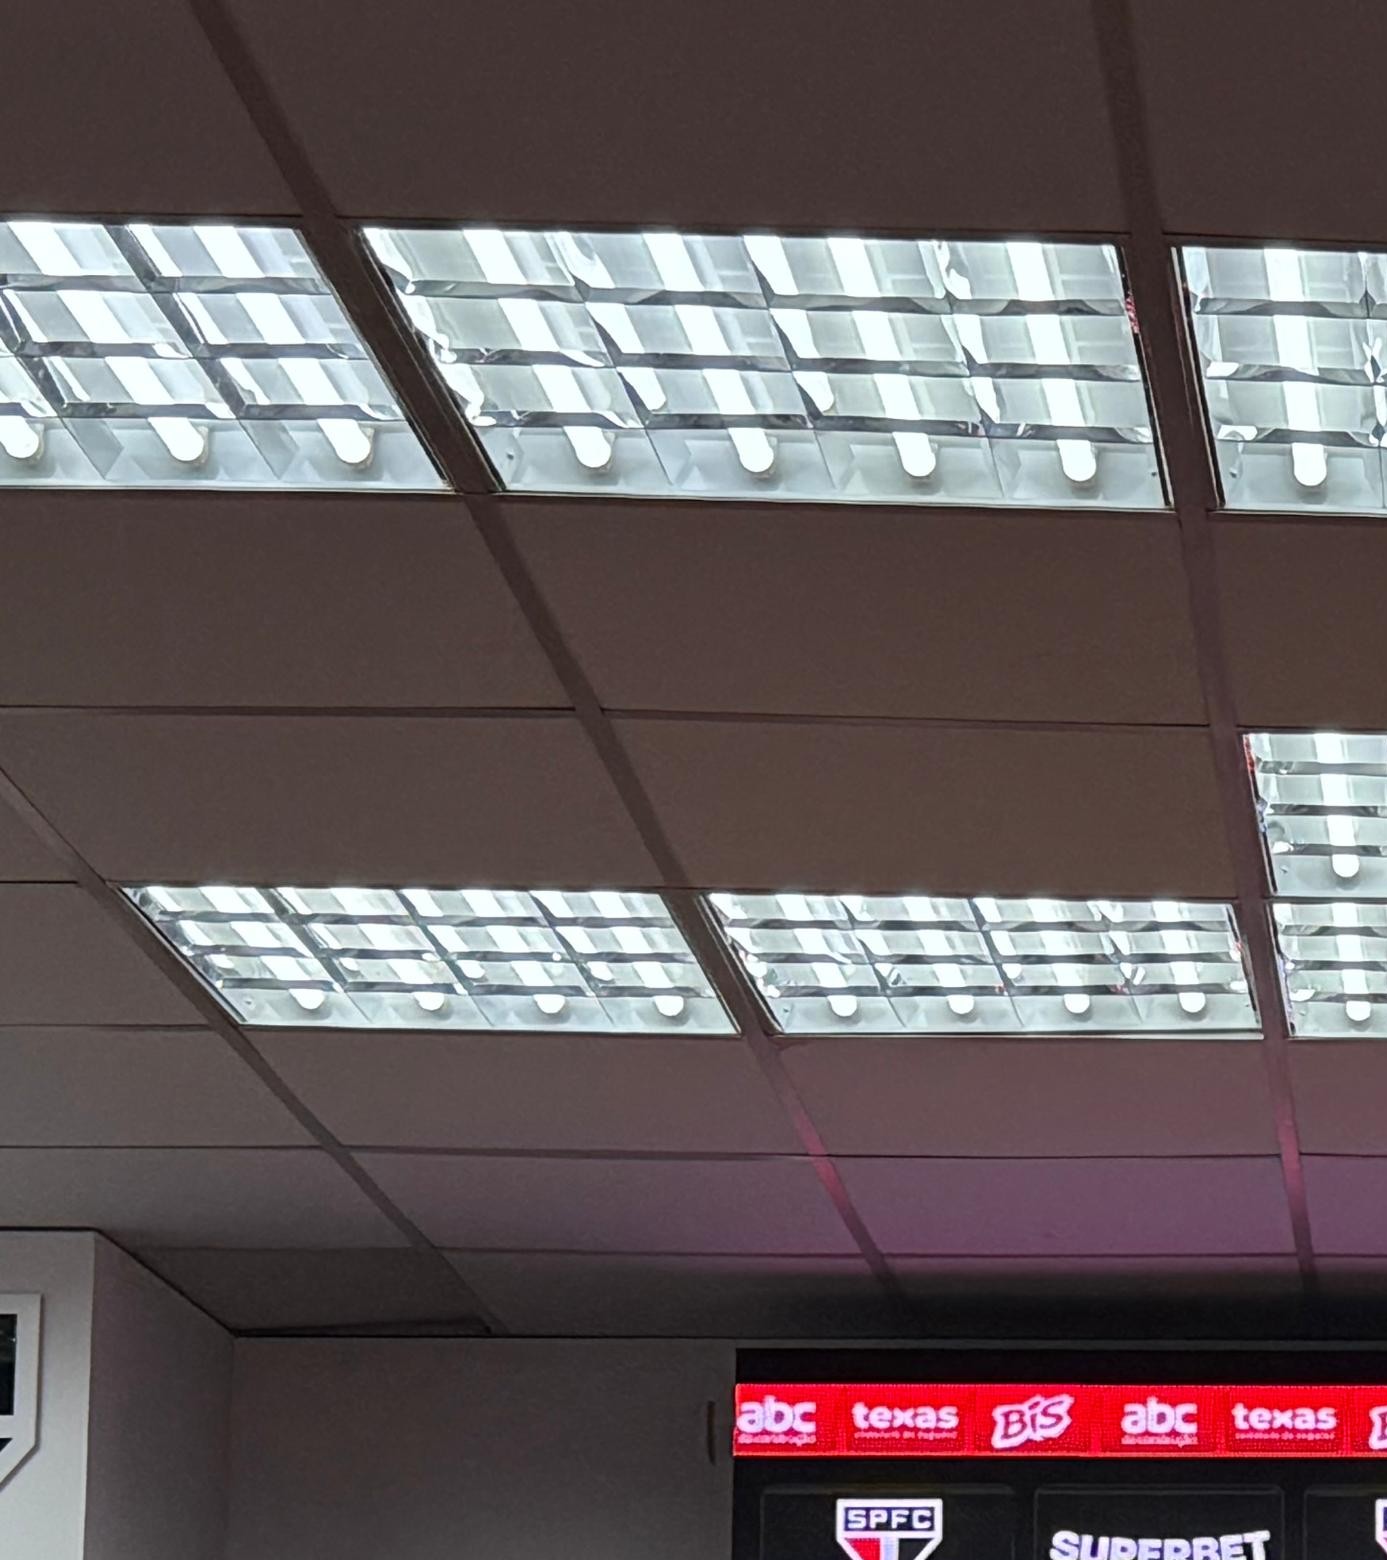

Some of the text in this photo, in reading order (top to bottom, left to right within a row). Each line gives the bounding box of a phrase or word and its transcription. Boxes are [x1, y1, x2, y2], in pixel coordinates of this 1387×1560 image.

[737, 1395, 816, 1433] abc
[851, 1402, 959, 1429] texas
[1121, 1396, 1198, 1435] abc
[1232, 1402, 1337, 1430] texas
[846, 1508, 933, 1529] SPFC
